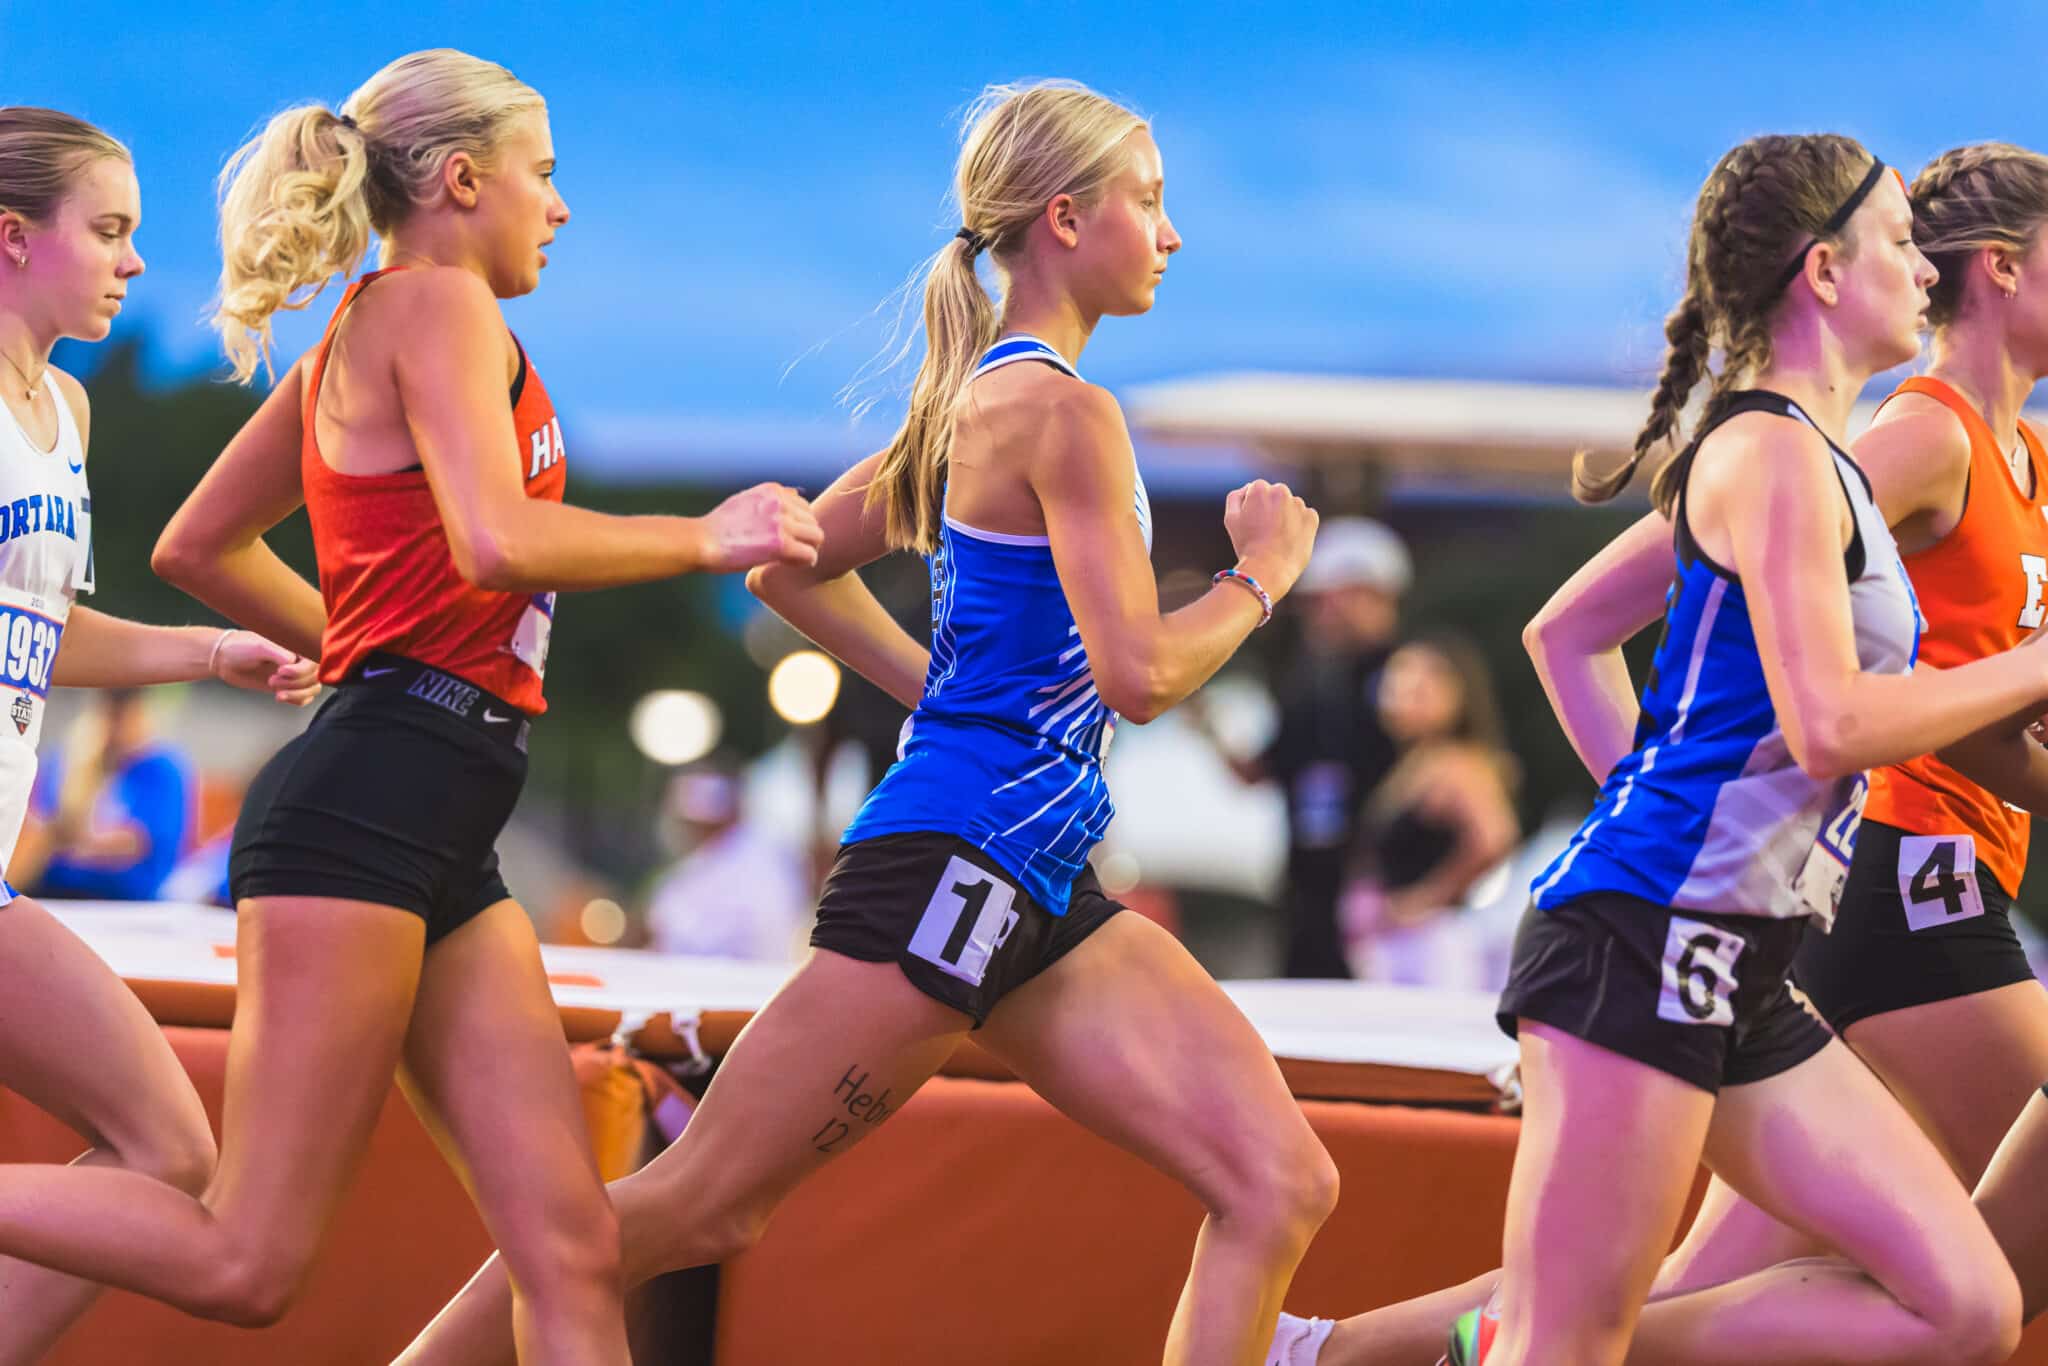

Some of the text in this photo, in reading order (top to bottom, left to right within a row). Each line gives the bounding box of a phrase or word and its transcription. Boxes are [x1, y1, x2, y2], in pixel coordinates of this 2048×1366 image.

[407, 668, 480, 717] NIKE
[1909, 841, 1967, 915] 4
[939, 878, 994, 966] 1
[1676, 932, 1721, 1019] 6
[812, 1117, 849, 1152] 12
